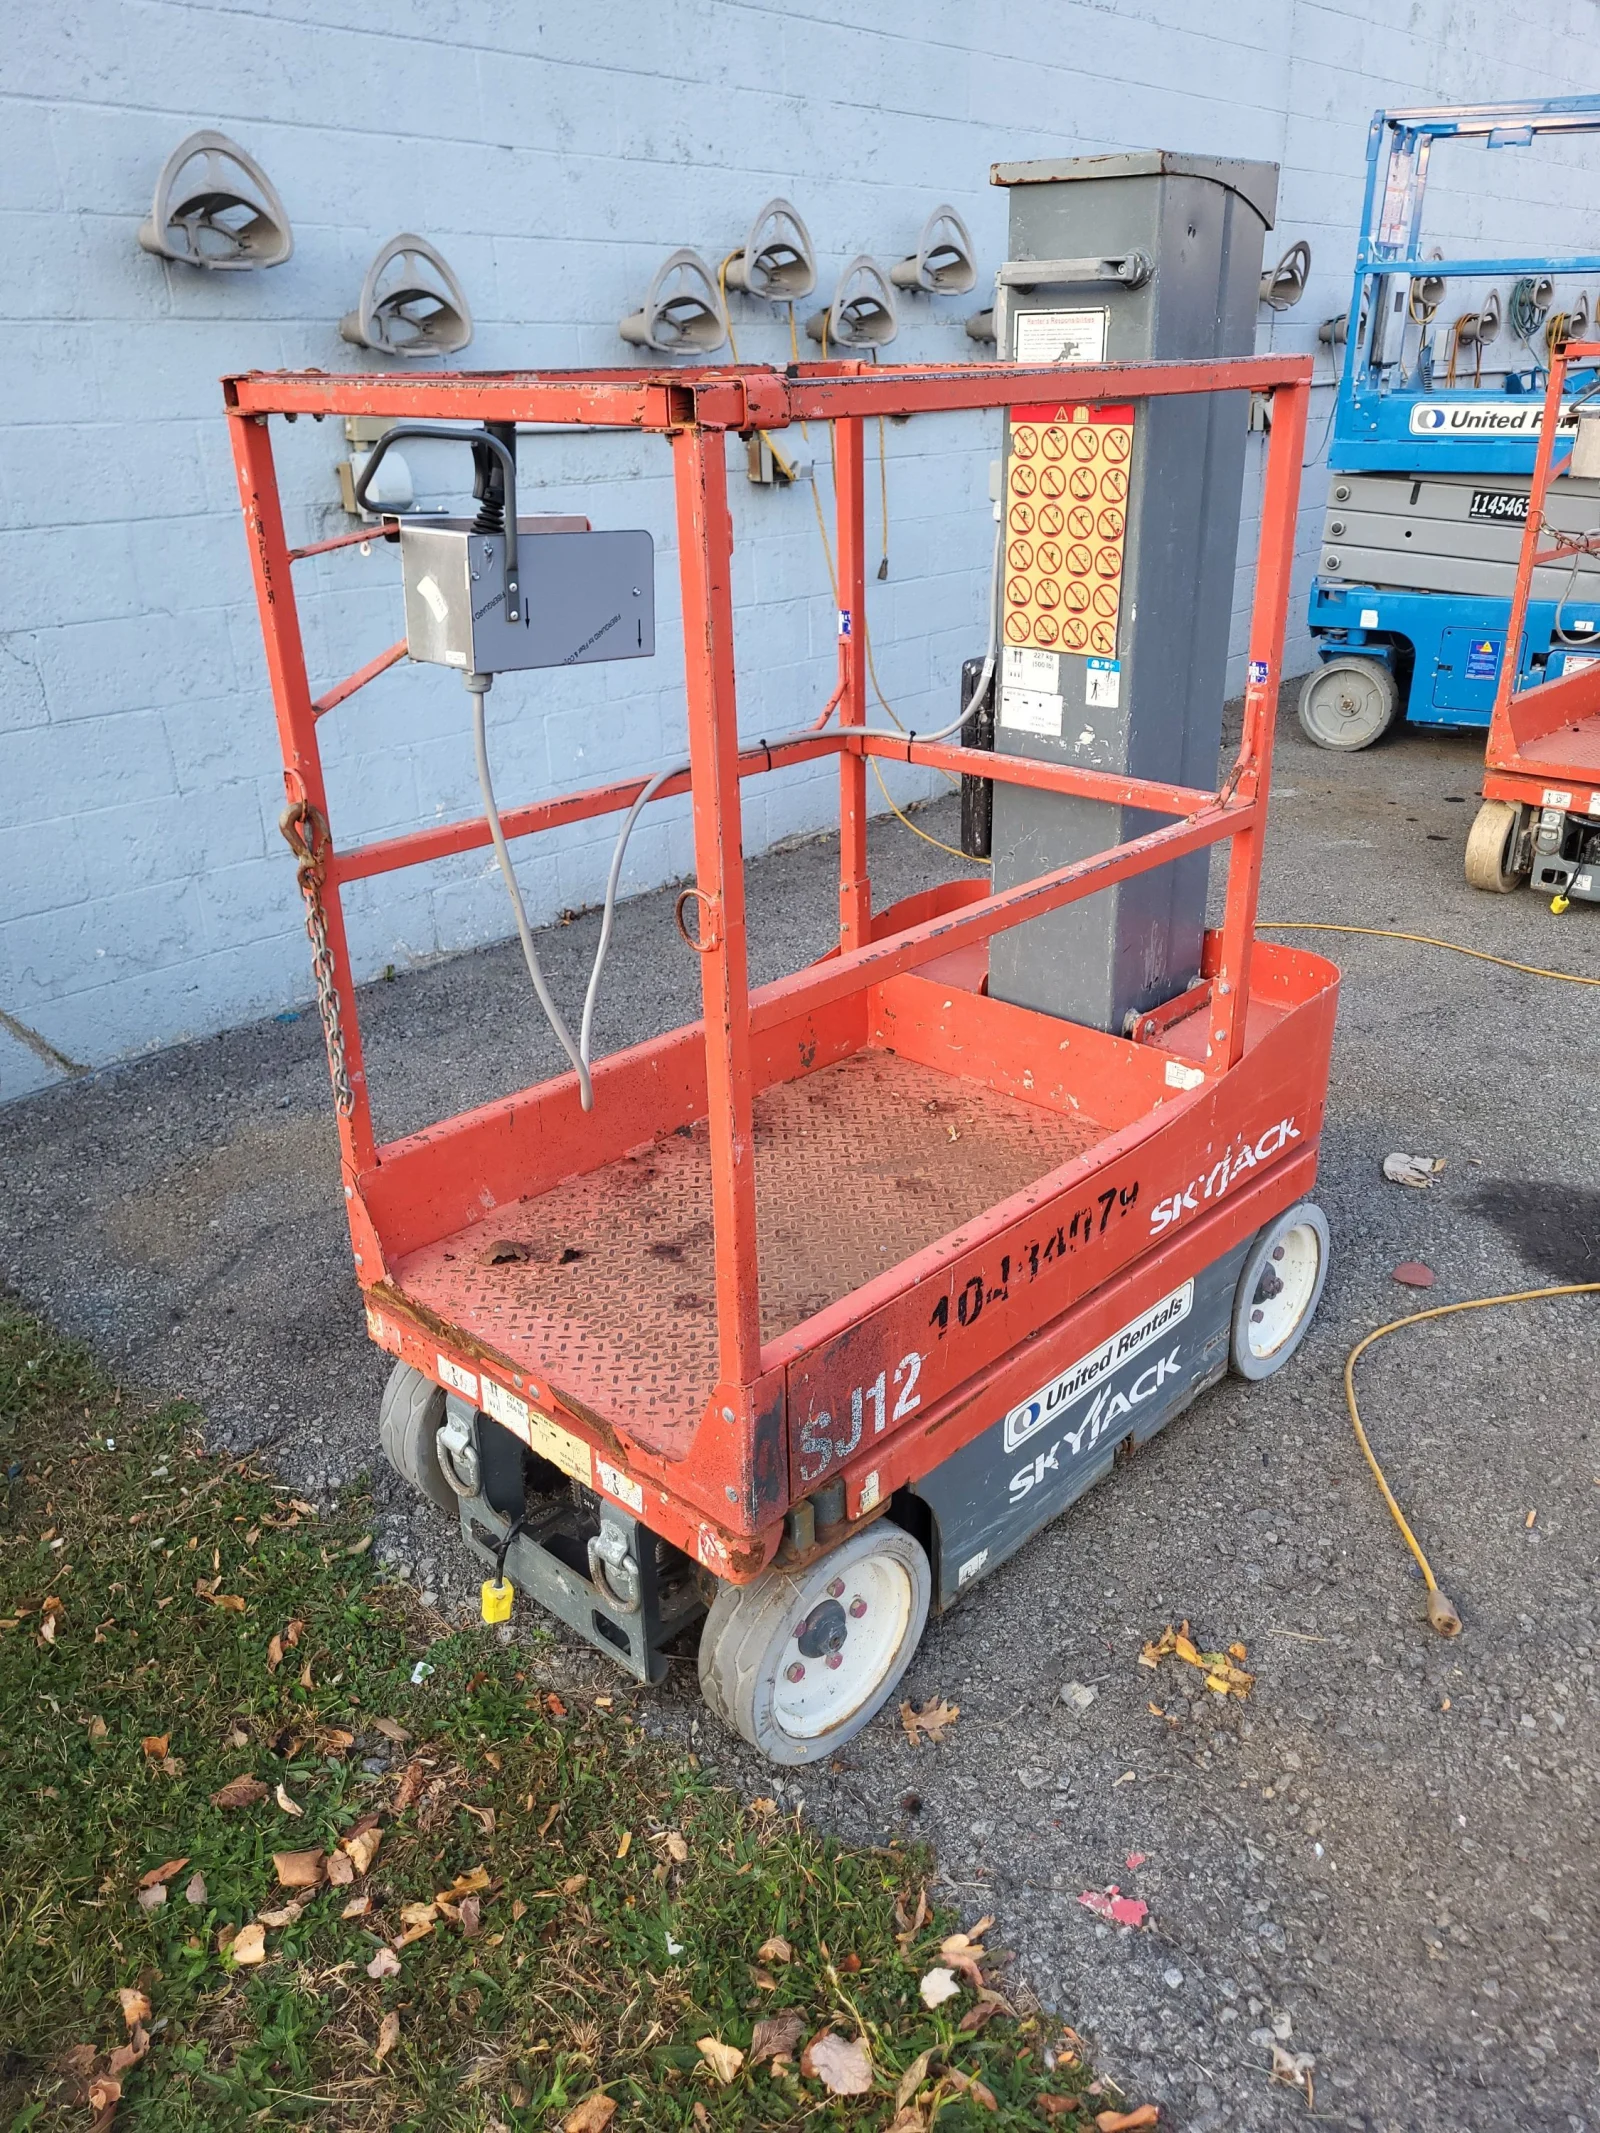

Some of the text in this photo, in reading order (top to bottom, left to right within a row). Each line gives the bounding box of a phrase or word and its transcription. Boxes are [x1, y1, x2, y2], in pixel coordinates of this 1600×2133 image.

[1050, 316, 1095, 326] Responsibilities
[1450, 410, 1527, 429] United
[1045, 653, 1053, 661] kg
[1149, 1115, 1301, 1236] SKYJACK
[1046, 1296, 1184, 1411] United Rentals
[800, 1352, 923, 1481] SJ12
[1009, 1345, 1181, 1504] SKYJACK
